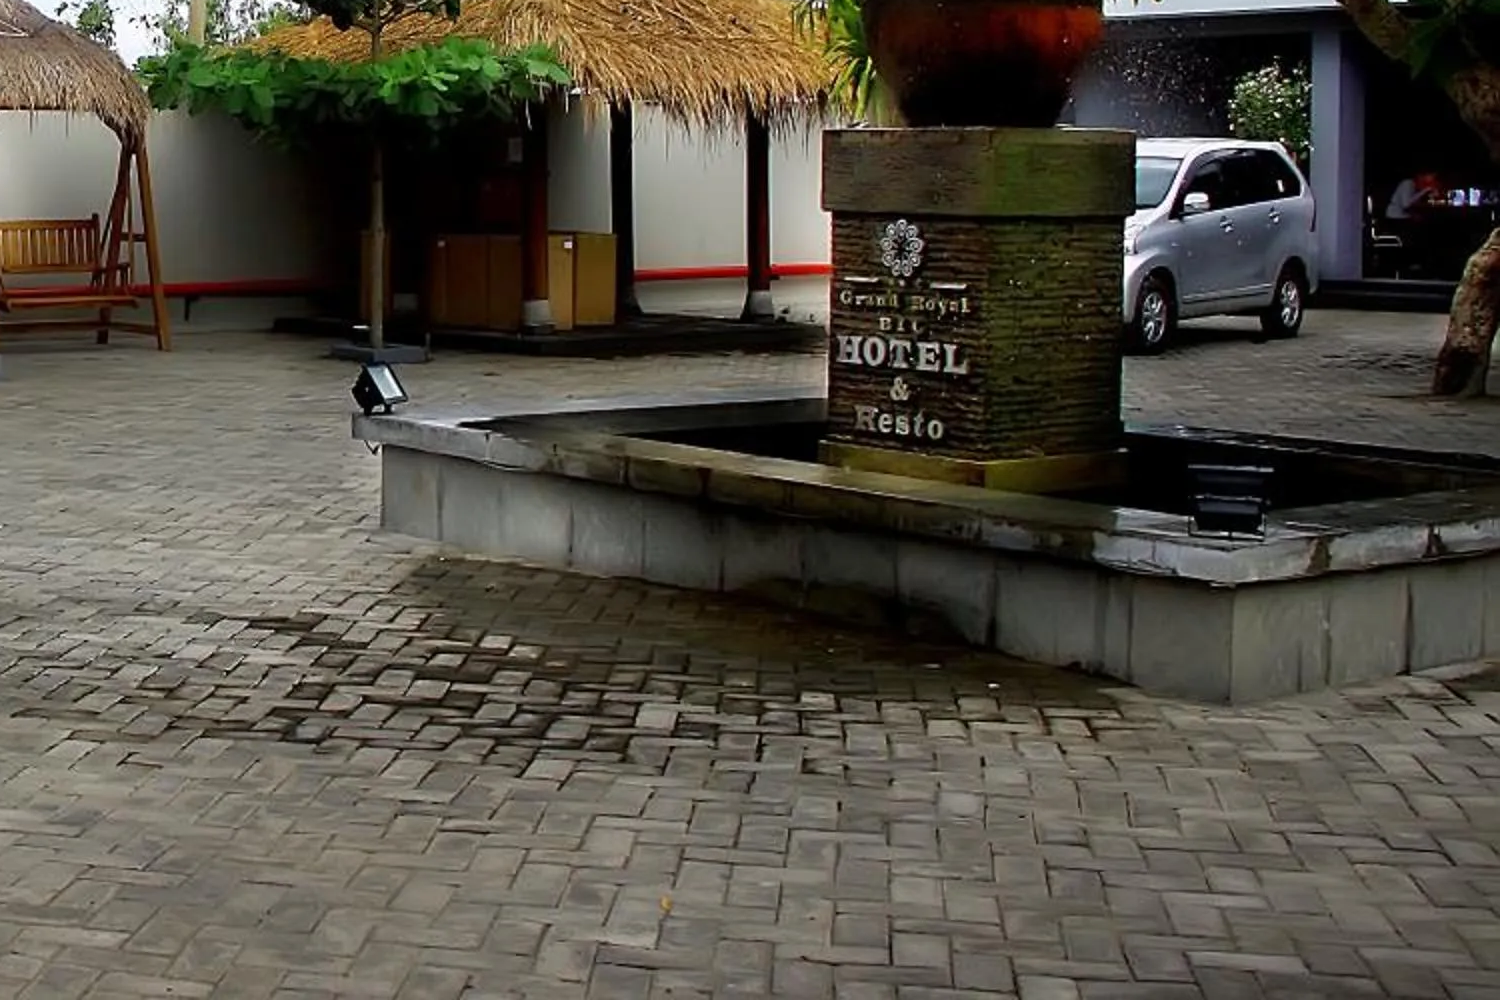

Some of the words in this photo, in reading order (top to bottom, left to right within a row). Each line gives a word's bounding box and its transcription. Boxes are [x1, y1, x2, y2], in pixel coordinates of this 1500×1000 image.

[839, 290, 899, 308] Grand
[911, 296, 971, 315] Royal
[836, 335, 969, 374] HOTEL
[890, 376, 910, 401] &
[854, 405, 943, 439] Resto
